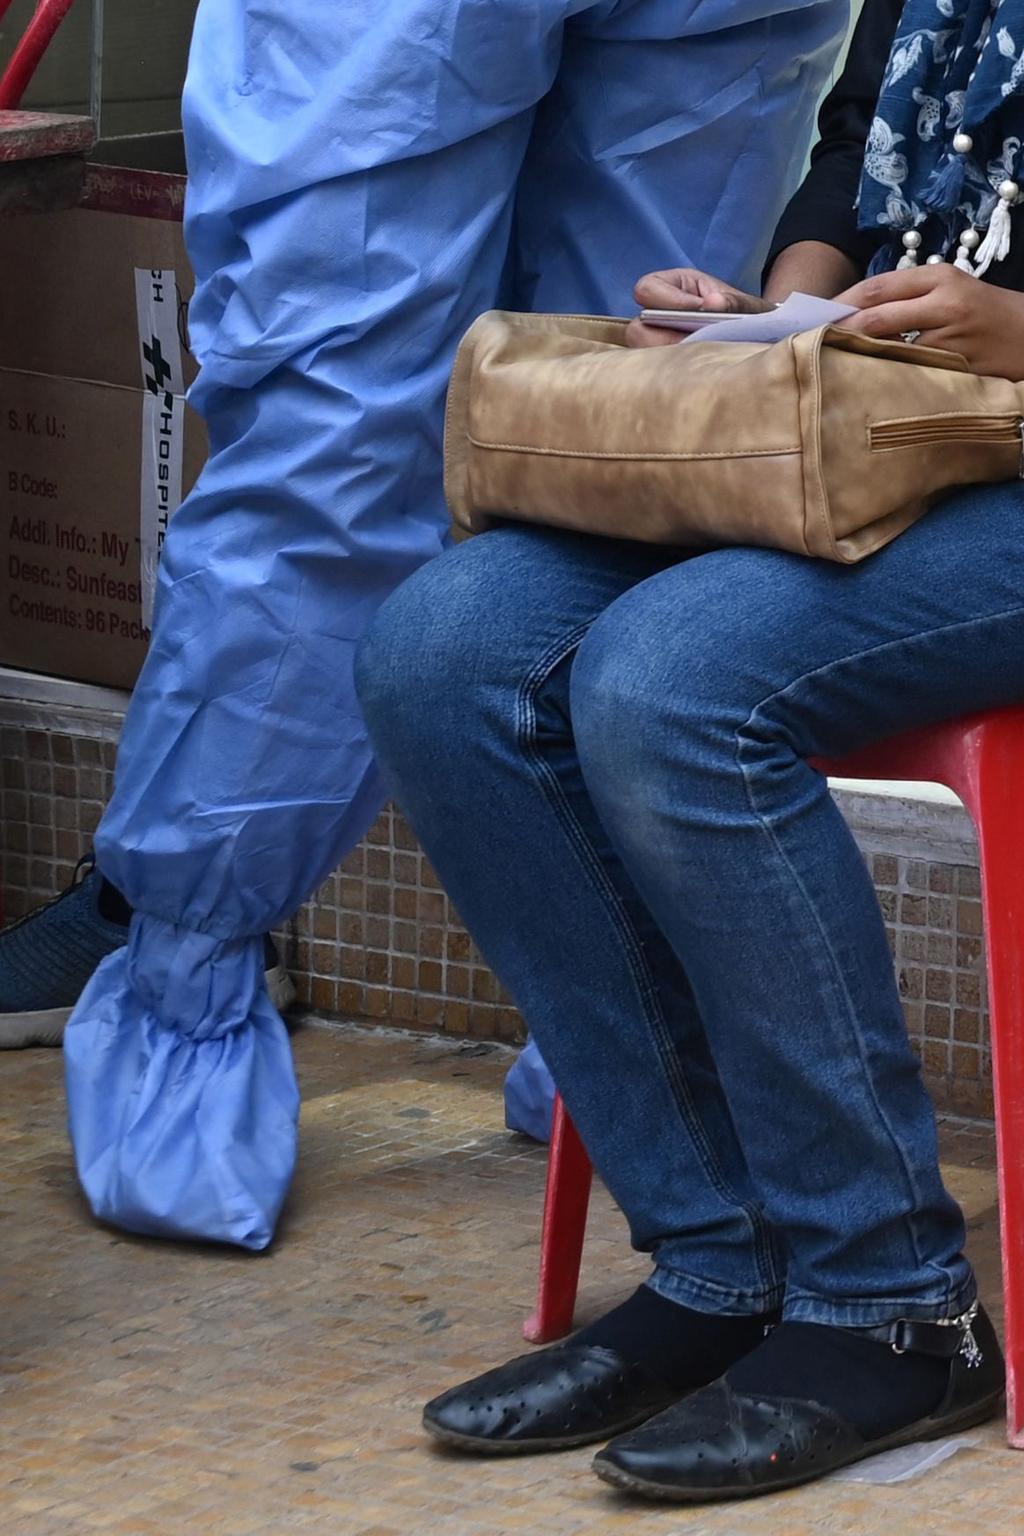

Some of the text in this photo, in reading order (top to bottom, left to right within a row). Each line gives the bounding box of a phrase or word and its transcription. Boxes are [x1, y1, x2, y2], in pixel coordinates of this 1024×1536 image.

[8, 471, 18, 492] B
[156, 411, 173, 561] HOSPITE
[102, 531, 129, 567] My
[9, 593, 82, 630] Contents:
[86, 608, 105, 633] 96
